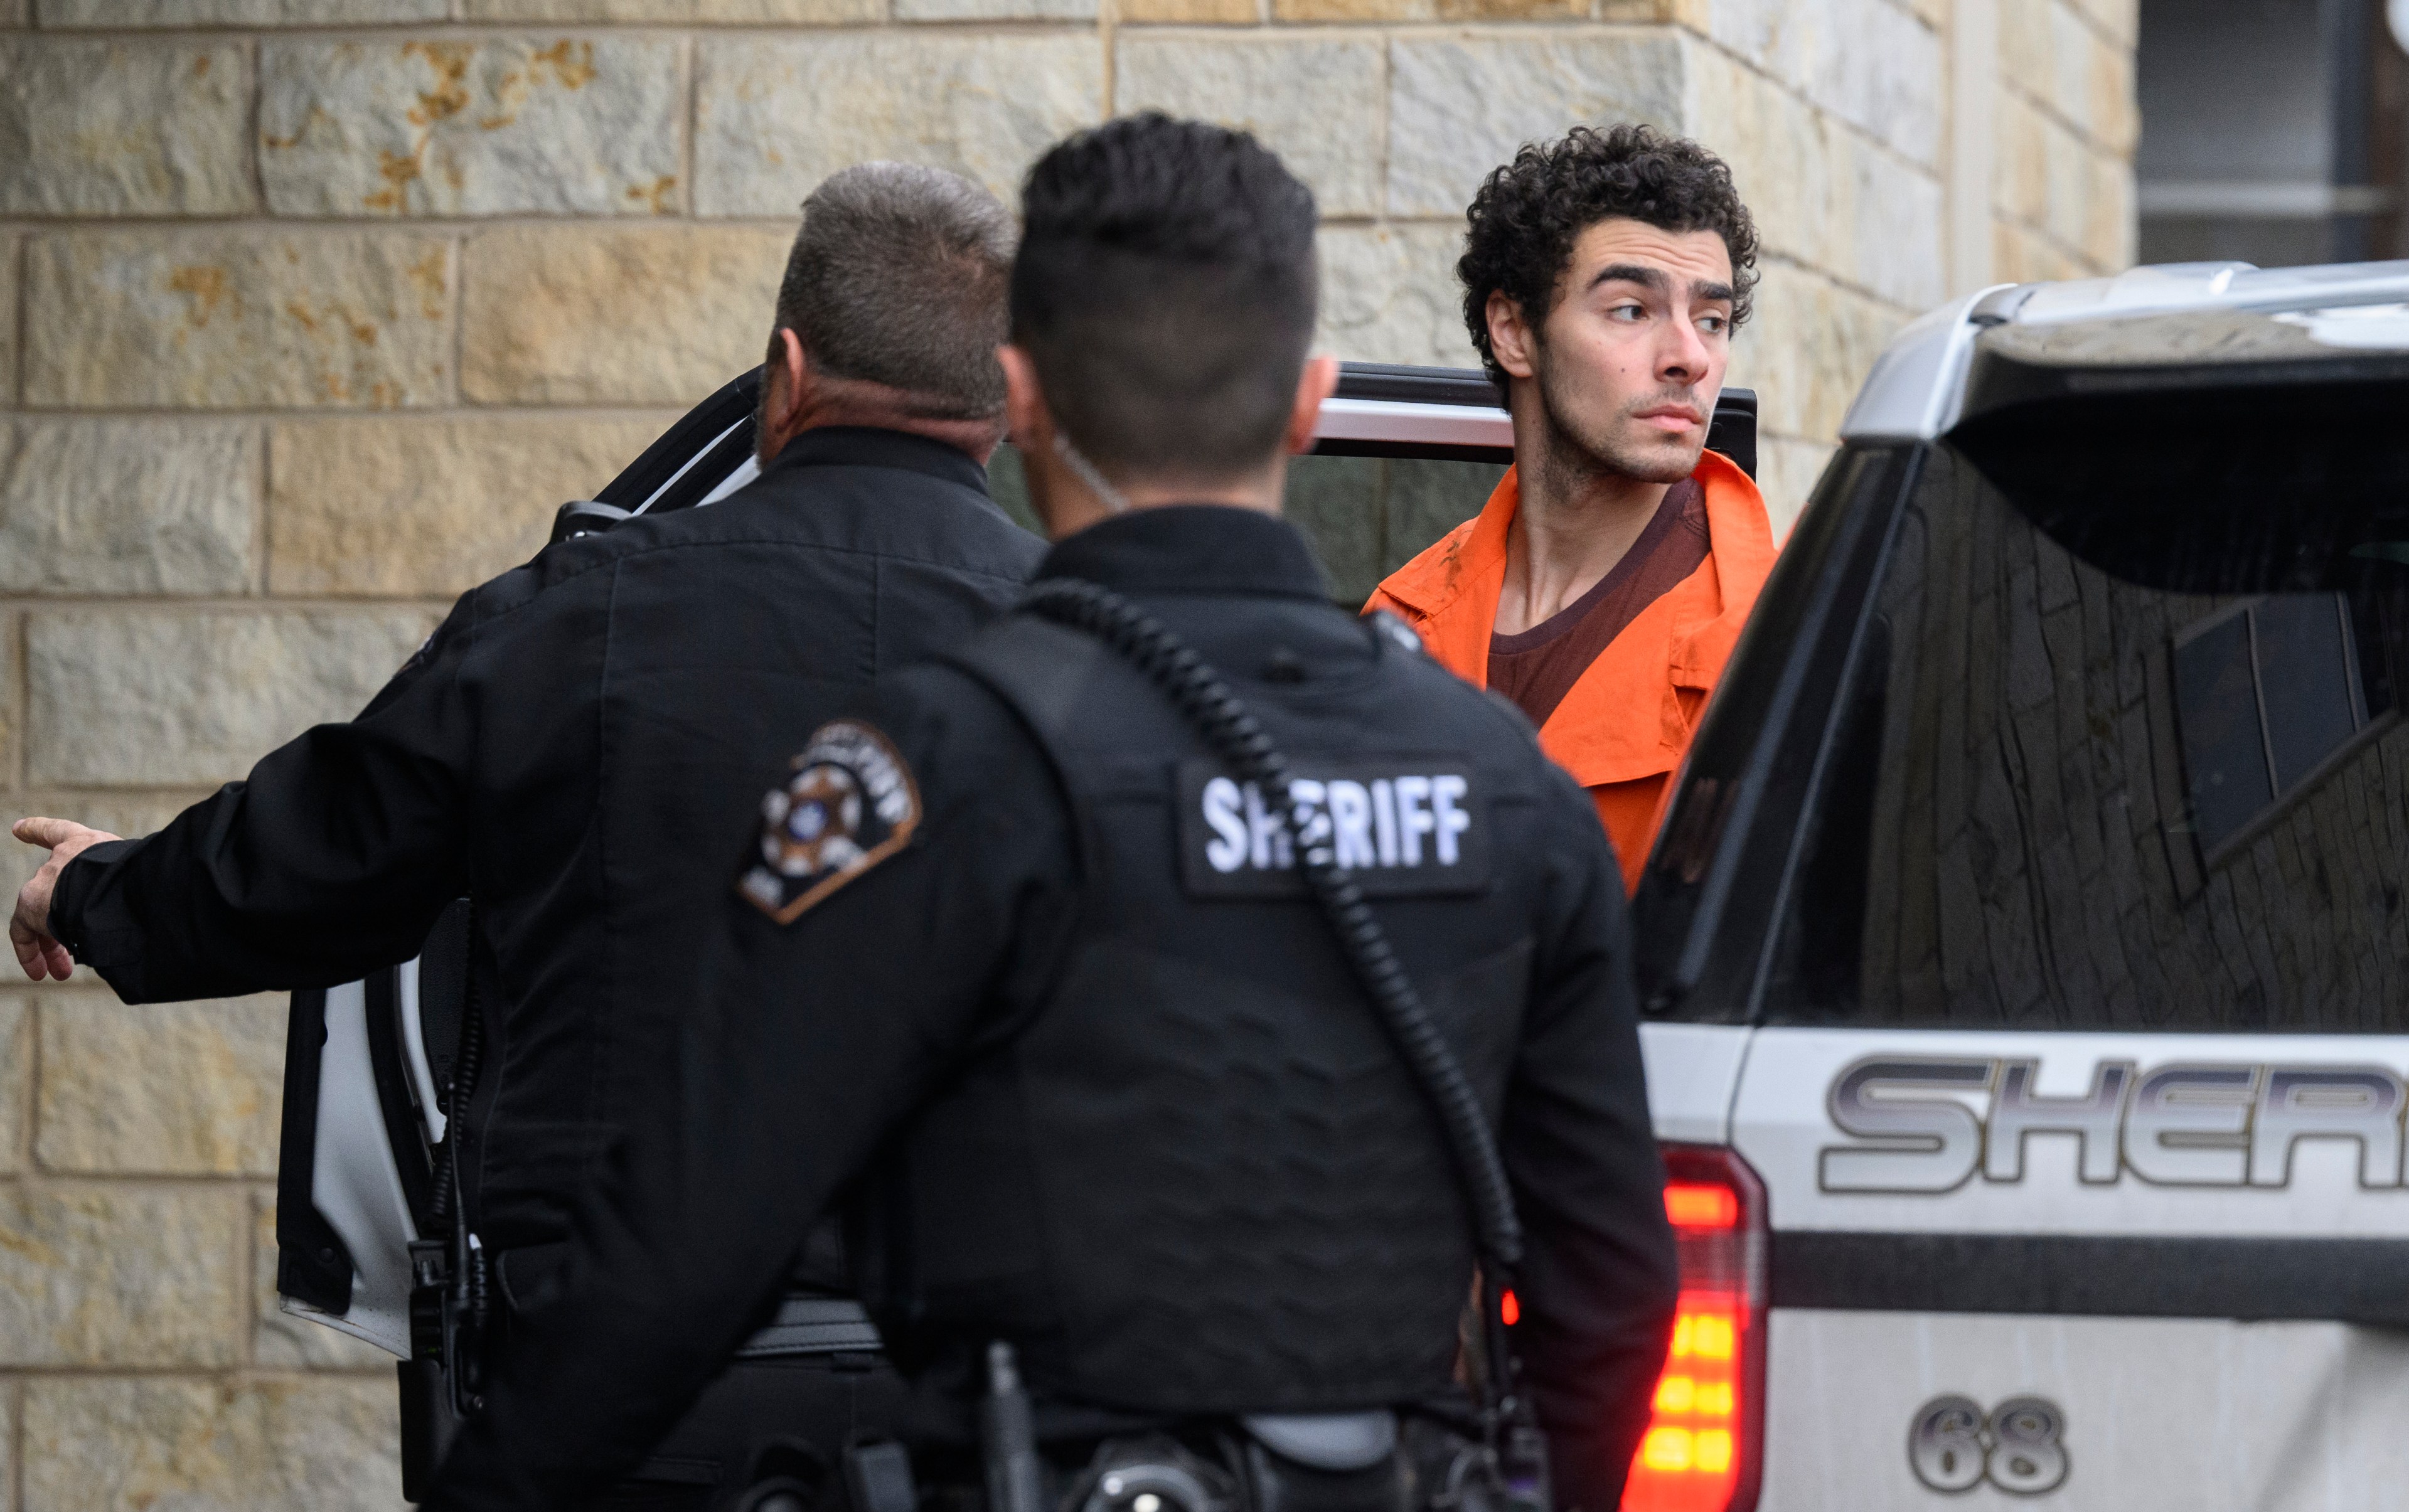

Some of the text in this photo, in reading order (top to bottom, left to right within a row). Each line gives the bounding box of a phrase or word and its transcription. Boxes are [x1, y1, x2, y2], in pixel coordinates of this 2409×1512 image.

[1202, 775, 1470, 873] SHERIFF
[1819, 1053, 2409, 1195] SHER
[1908, 1394, 2071, 1496] 68
